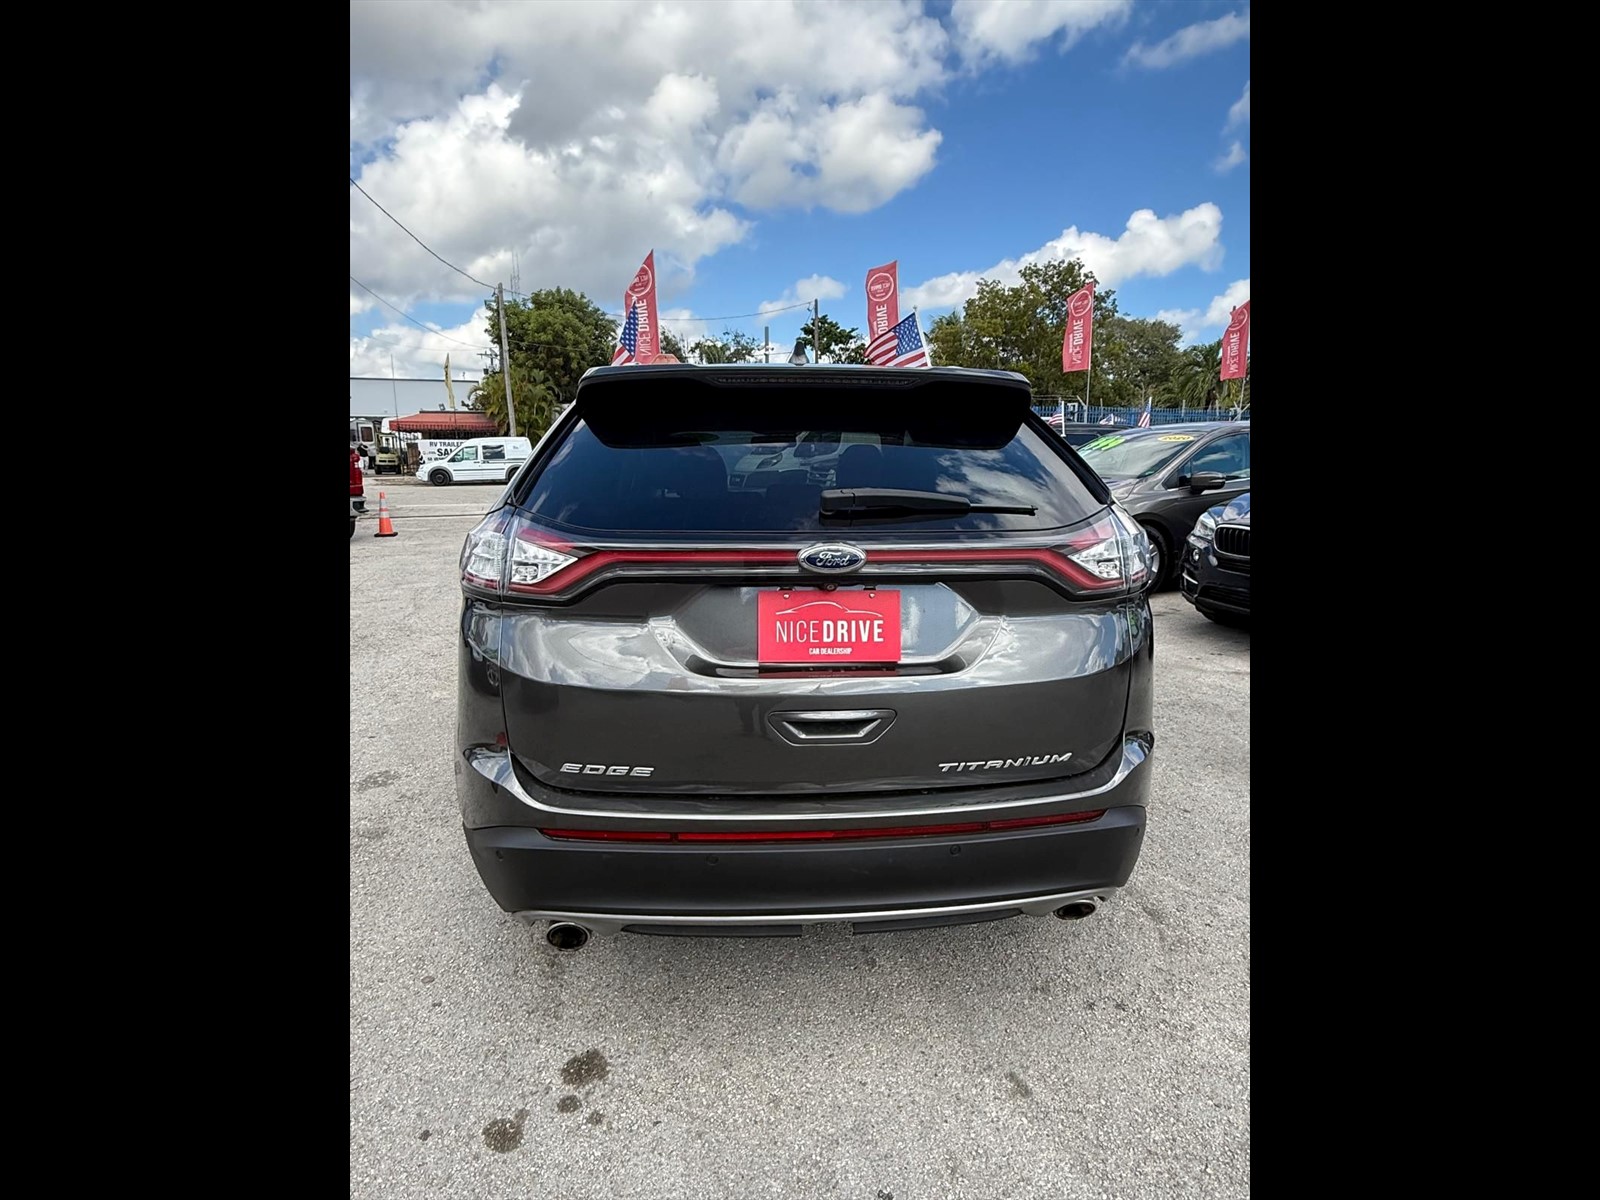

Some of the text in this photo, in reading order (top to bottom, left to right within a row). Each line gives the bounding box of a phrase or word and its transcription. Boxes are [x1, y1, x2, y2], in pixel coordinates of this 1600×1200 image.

[815, 550, 851, 567] Ford
[808, 647, 853, 655] CAR DEALERSHIP
[559, 762, 655, 778] EDGE
[938, 752, 1073, 772] TITANIUM
